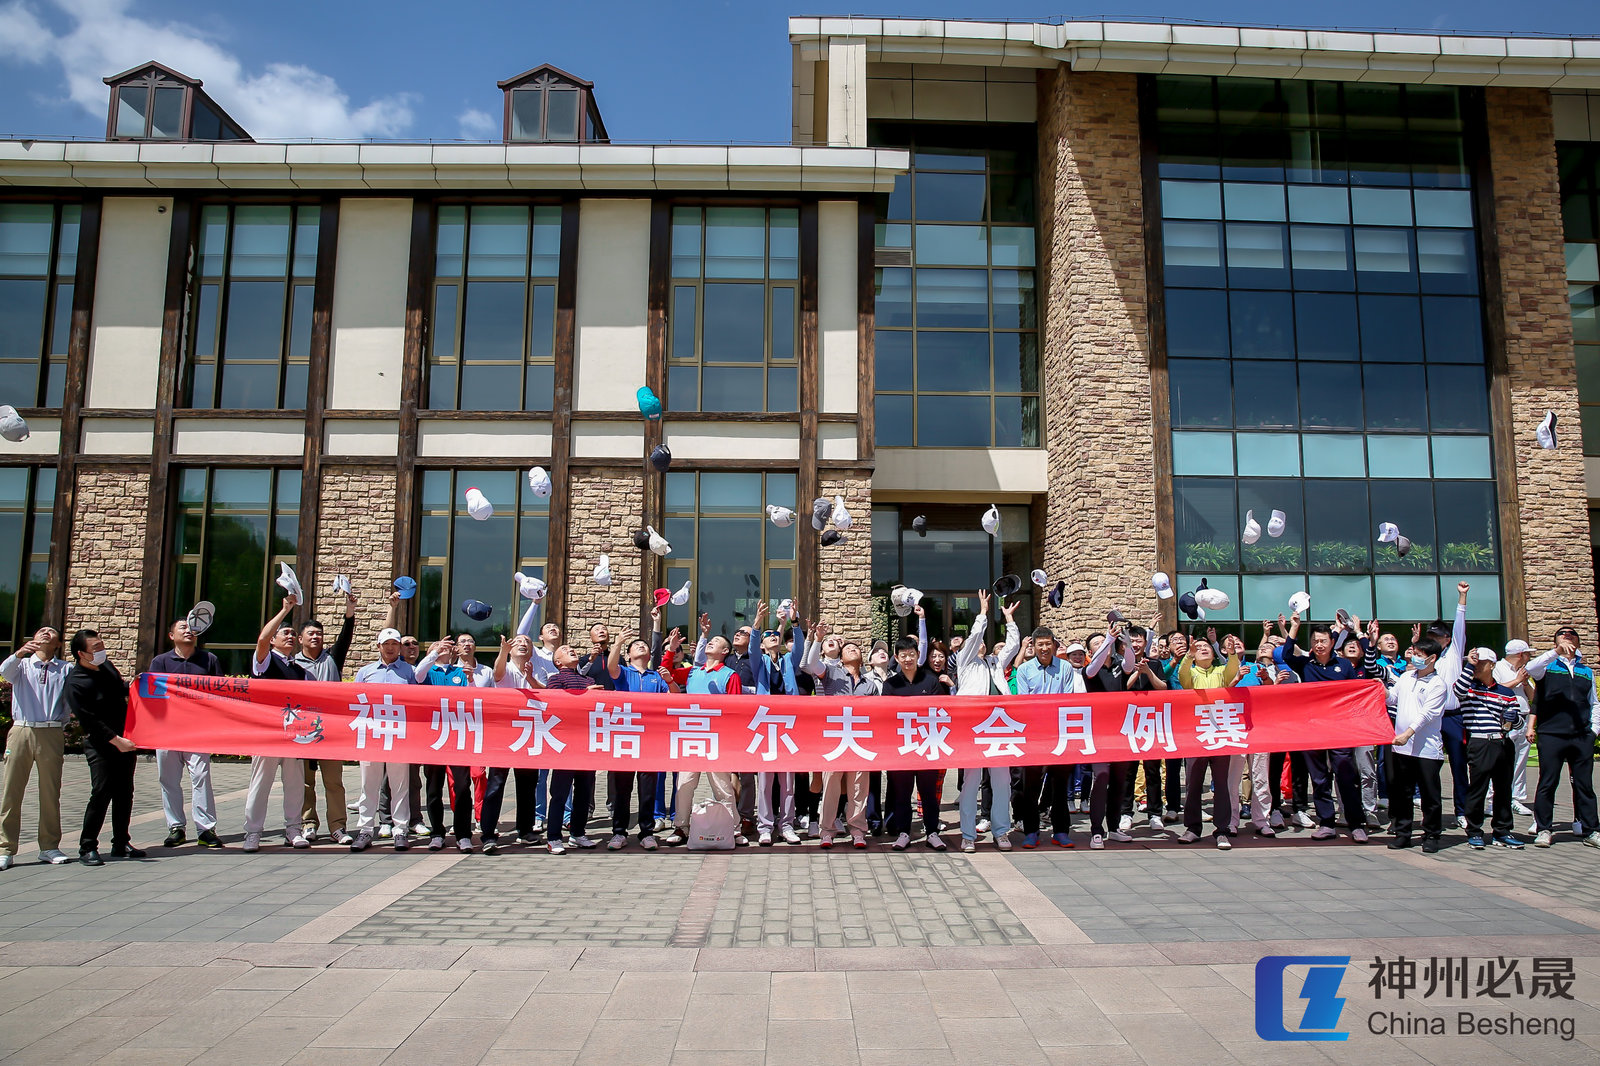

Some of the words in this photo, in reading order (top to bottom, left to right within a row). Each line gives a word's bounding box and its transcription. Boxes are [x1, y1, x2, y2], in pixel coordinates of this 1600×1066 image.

[174, 676, 250, 694] 神州必晟
[349, 692, 1250, 763] 神州永皓高尔夫球会月例赛
